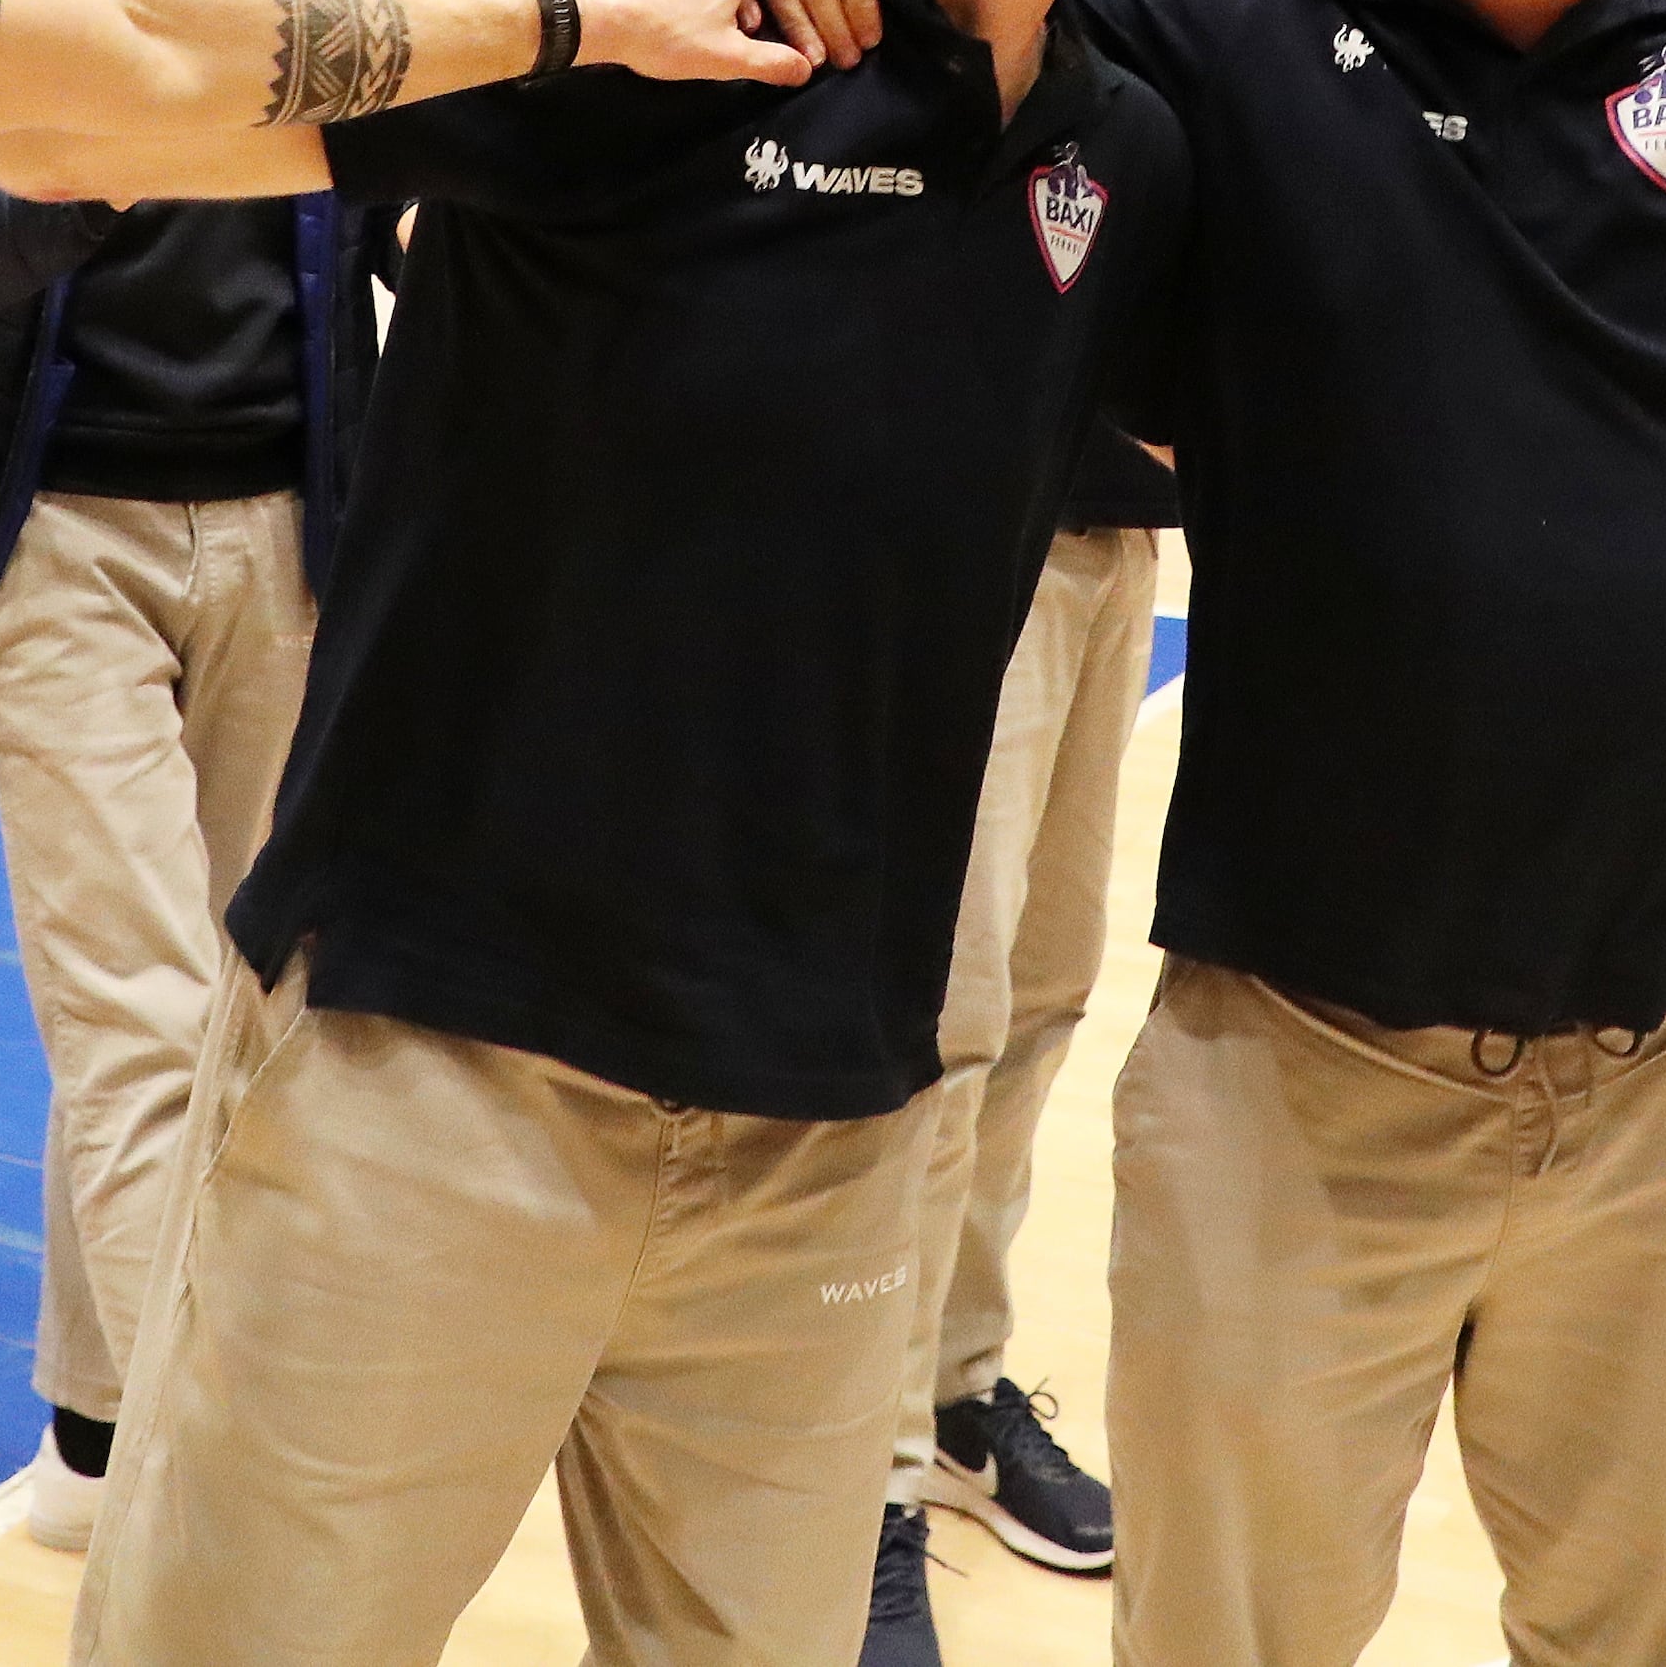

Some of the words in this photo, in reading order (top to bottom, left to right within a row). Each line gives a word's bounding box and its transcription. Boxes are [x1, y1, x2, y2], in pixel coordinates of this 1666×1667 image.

[791, 159, 925, 198] WAVES
[1046, 196, 1094, 234] BAXI
[819, 1265, 908, 1306] WAVES
